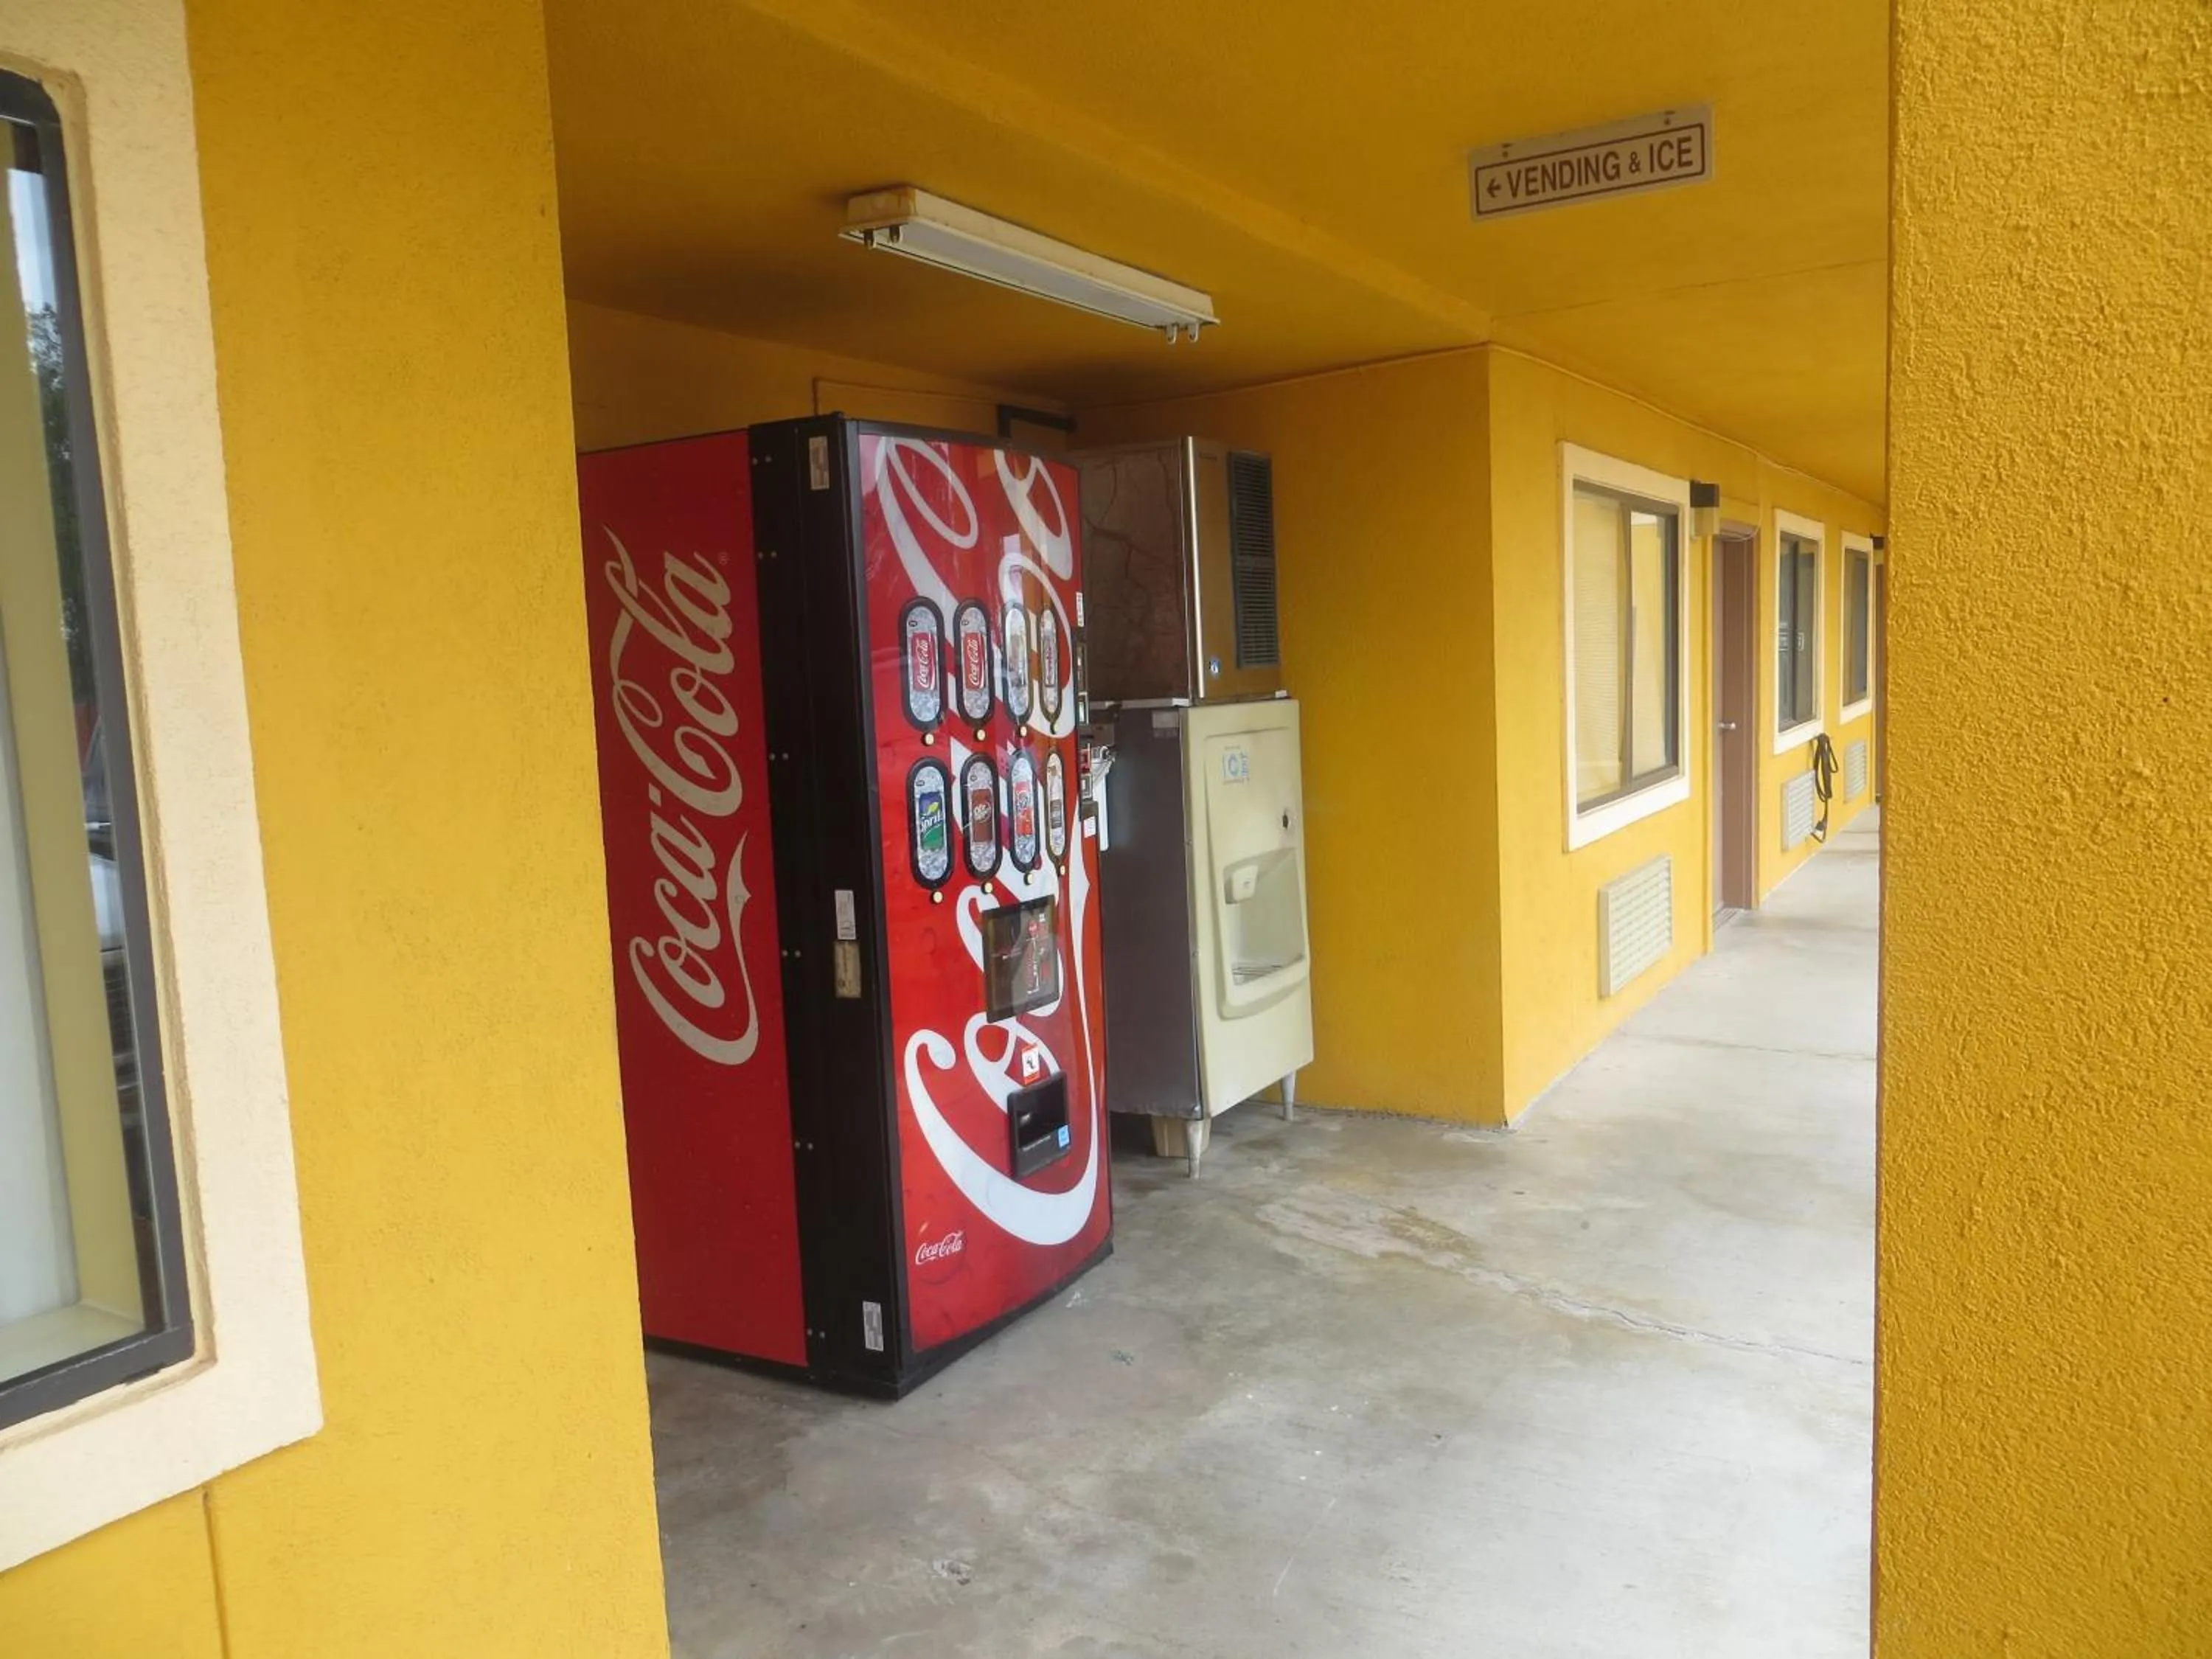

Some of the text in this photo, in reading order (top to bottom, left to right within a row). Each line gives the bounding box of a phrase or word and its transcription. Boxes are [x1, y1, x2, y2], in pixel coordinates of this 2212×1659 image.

[1506, 136, 1694, 199] VENDING & ICE
[603, 524, 759, 1065] Coca-Cola
